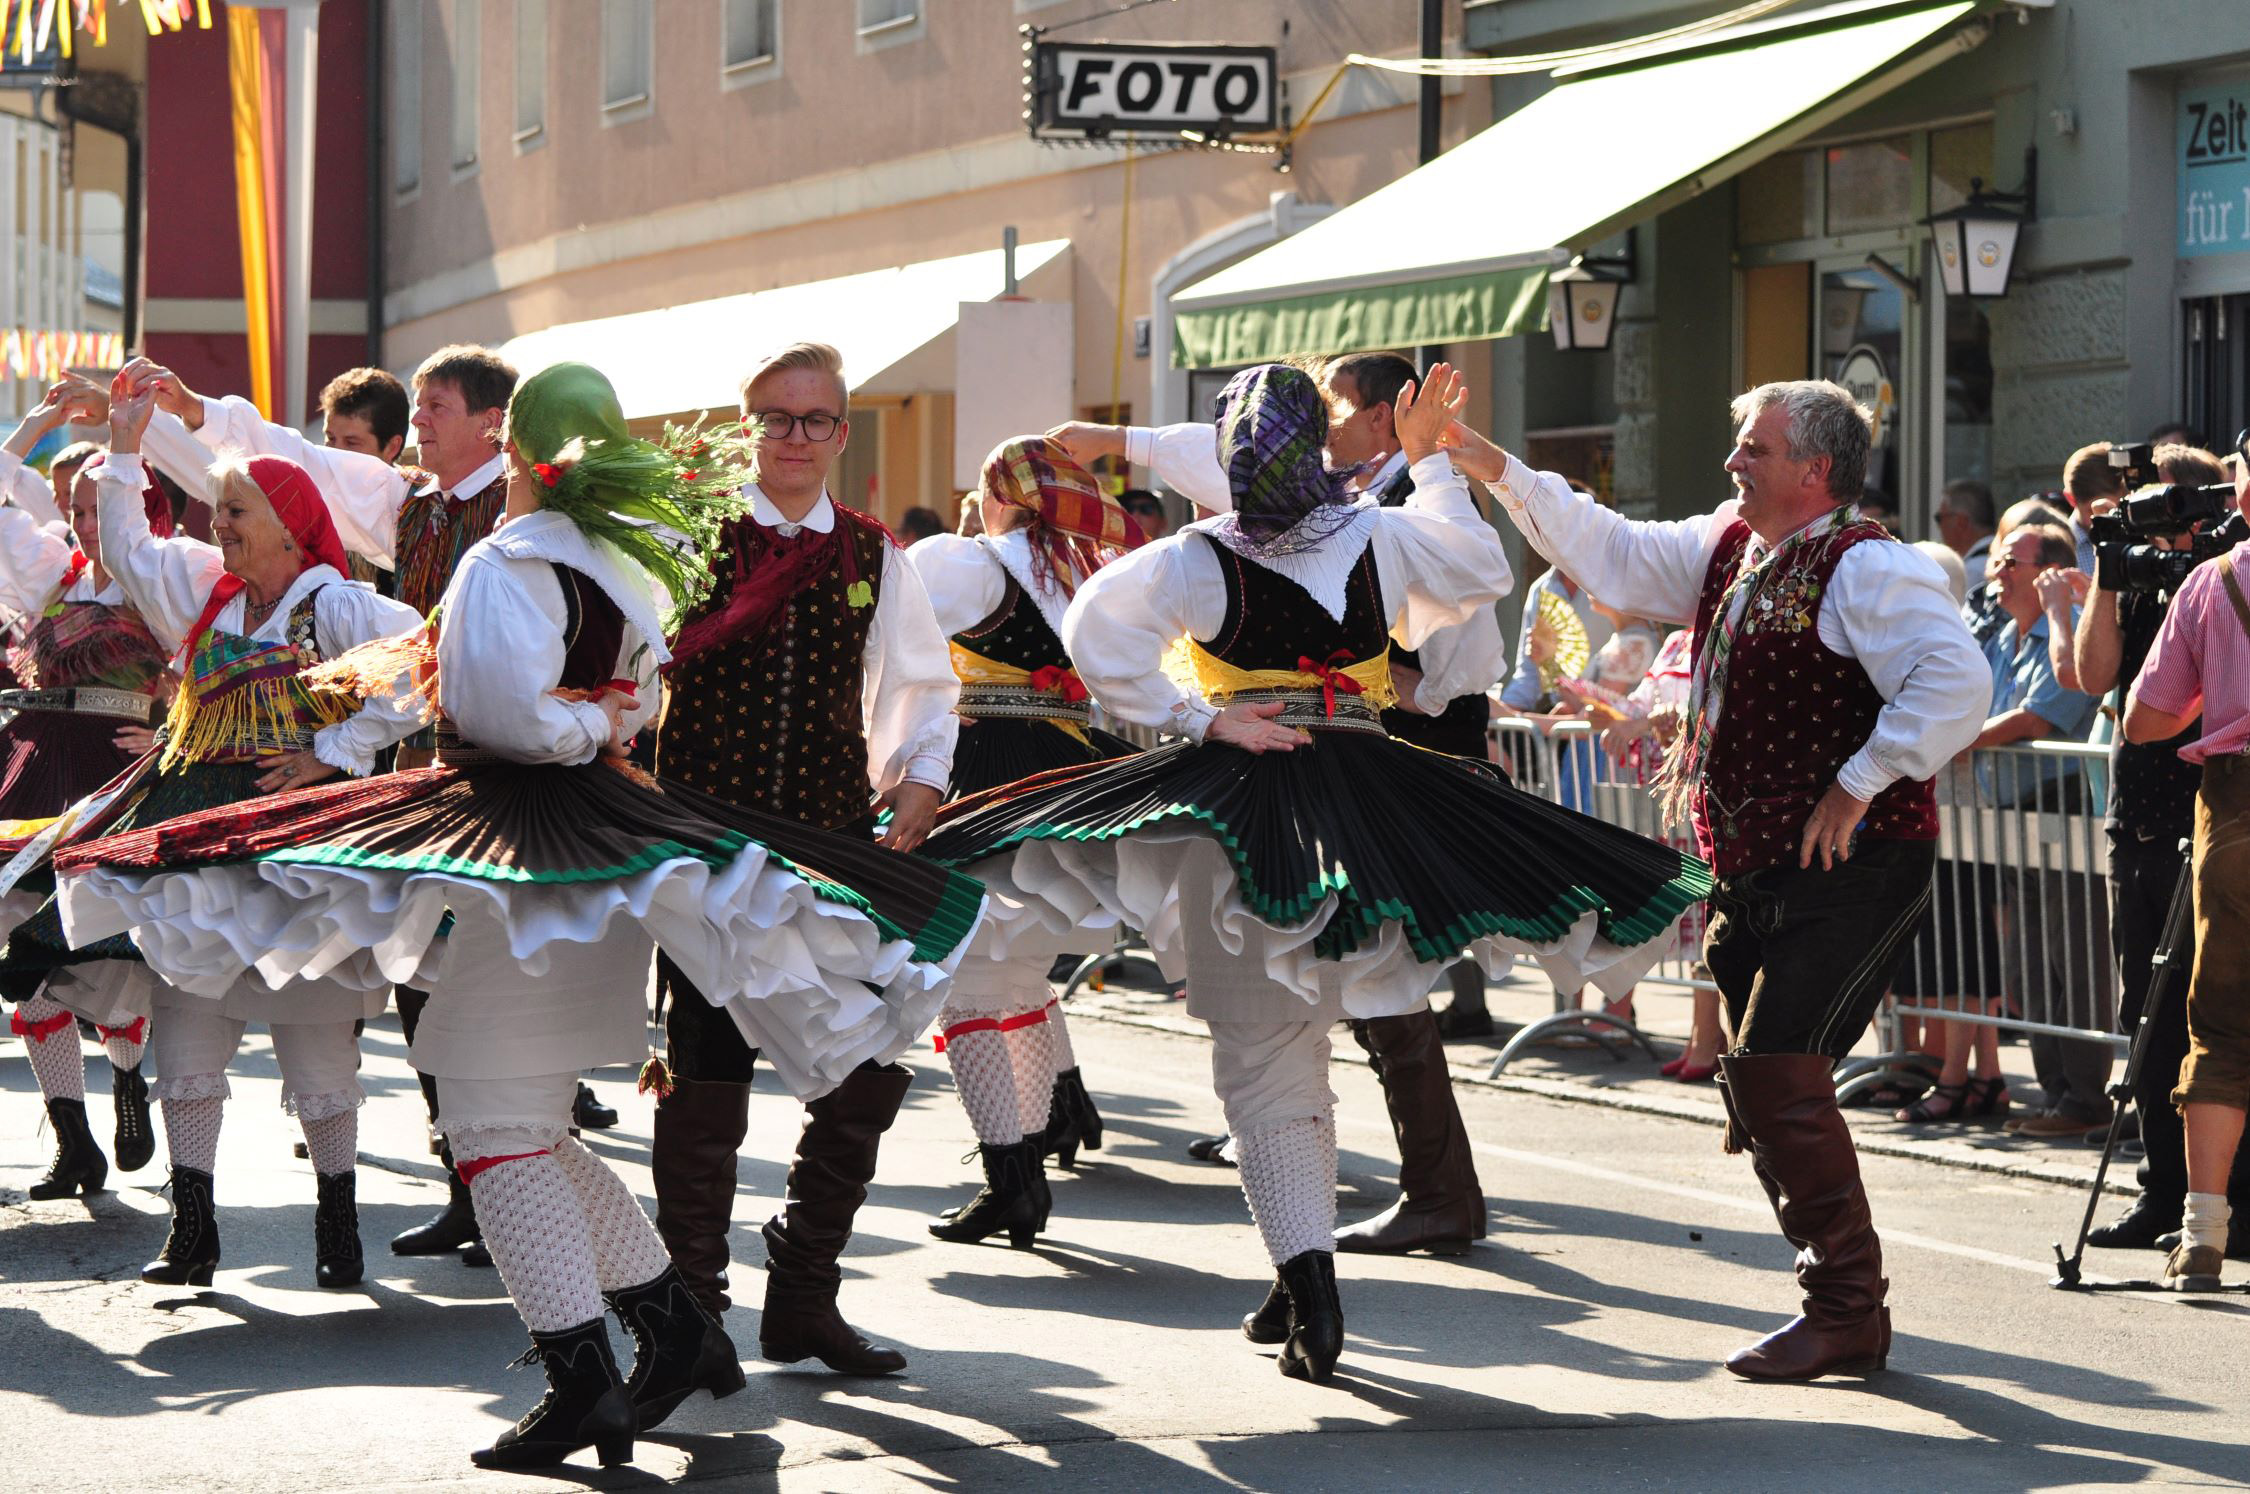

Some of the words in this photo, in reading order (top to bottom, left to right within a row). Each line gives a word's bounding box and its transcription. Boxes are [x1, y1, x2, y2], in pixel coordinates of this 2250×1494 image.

[1066, 59, 1259, 114] FOTO
[2187, 98, 2247, 157] Zeit
[2186, 190, 2233, 244] für
